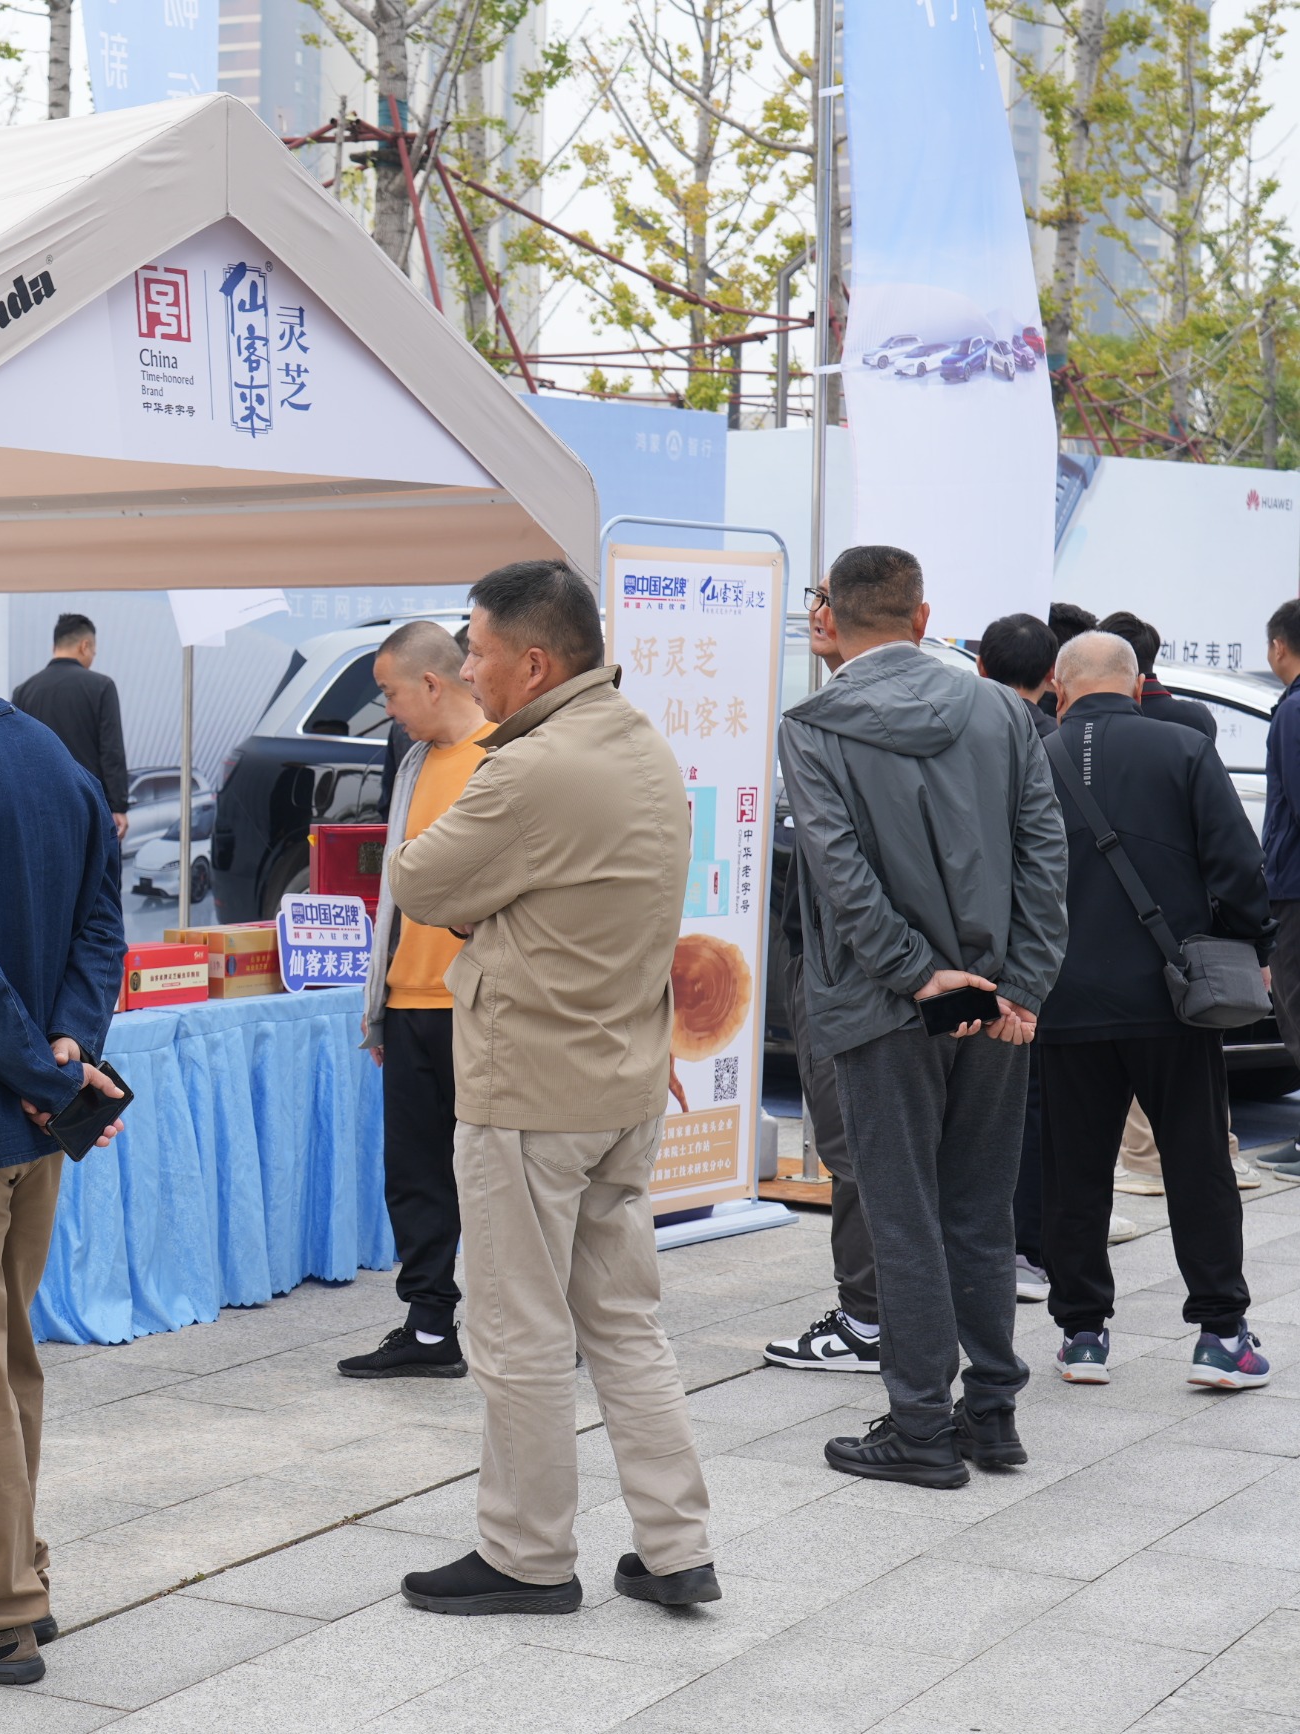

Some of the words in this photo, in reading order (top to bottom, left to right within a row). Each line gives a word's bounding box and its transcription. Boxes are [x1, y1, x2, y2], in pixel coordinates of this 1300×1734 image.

[139, 349, 179, 370] China
[277, 305, 312, 412] 灵芝
[141, 371, 194, 386] Time-honored
[141, 386, 164, 398] Brand
[142, 402, 196, 417] 中华老字号
[1261, 497, 1293, 512] HUAWEI
[636, 575, 687, 598] 中国名牌
[745, 590, 766, 608] 灵芝
[630, 636, 720, 678] 好灵芝
[661, 696, 749, 740] 仙客来
[1083, 722, 1094, 745] KELME
[740, 829, 753, 914] 中华老字号
[305, 903, 359, 927] 中国名牌
[288, 948, 371, 978] 仙客来灵芝
